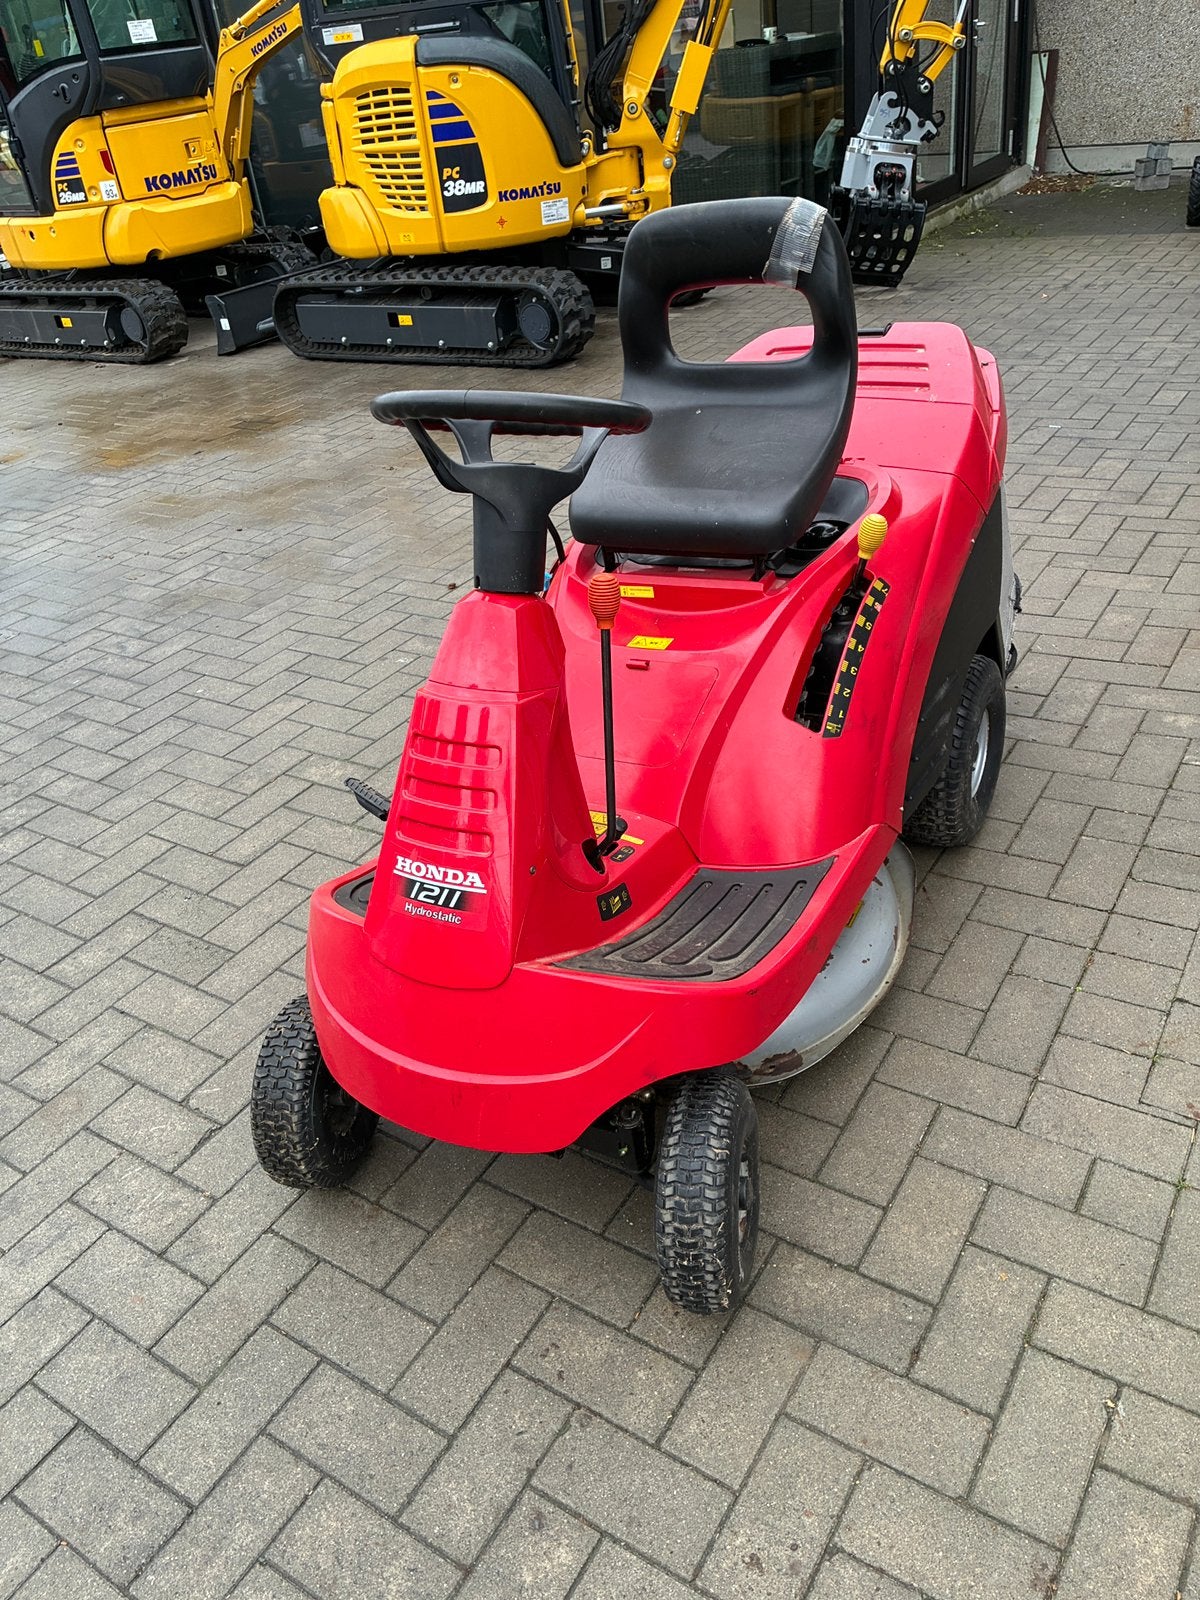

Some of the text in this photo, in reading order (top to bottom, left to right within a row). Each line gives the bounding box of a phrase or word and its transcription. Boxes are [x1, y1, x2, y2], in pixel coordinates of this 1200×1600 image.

[251, 22, 287, 57] KOMATSU
[144, 163, 218, 192] KOMATSU
[442, 166, 460, 180] PC
[57, 183, 68, 192] PC
[443, 179, 485, 197] 38MR
[498, 181, 561, 202] KOMATSU
[59, 191, 86, 203] 26MR
[865, 622, 872, 631] 5
[857, 644, 864, 652] 4
[850, 666, 857, 675] 3
[843, 688, 851, 697] 2
[839, 710, 844, 718] 1
[395, 855, 485, 888] HONDA
[410, 882, 461, 908] 1211
[404, 902, 462, 925] Hydrostatic
